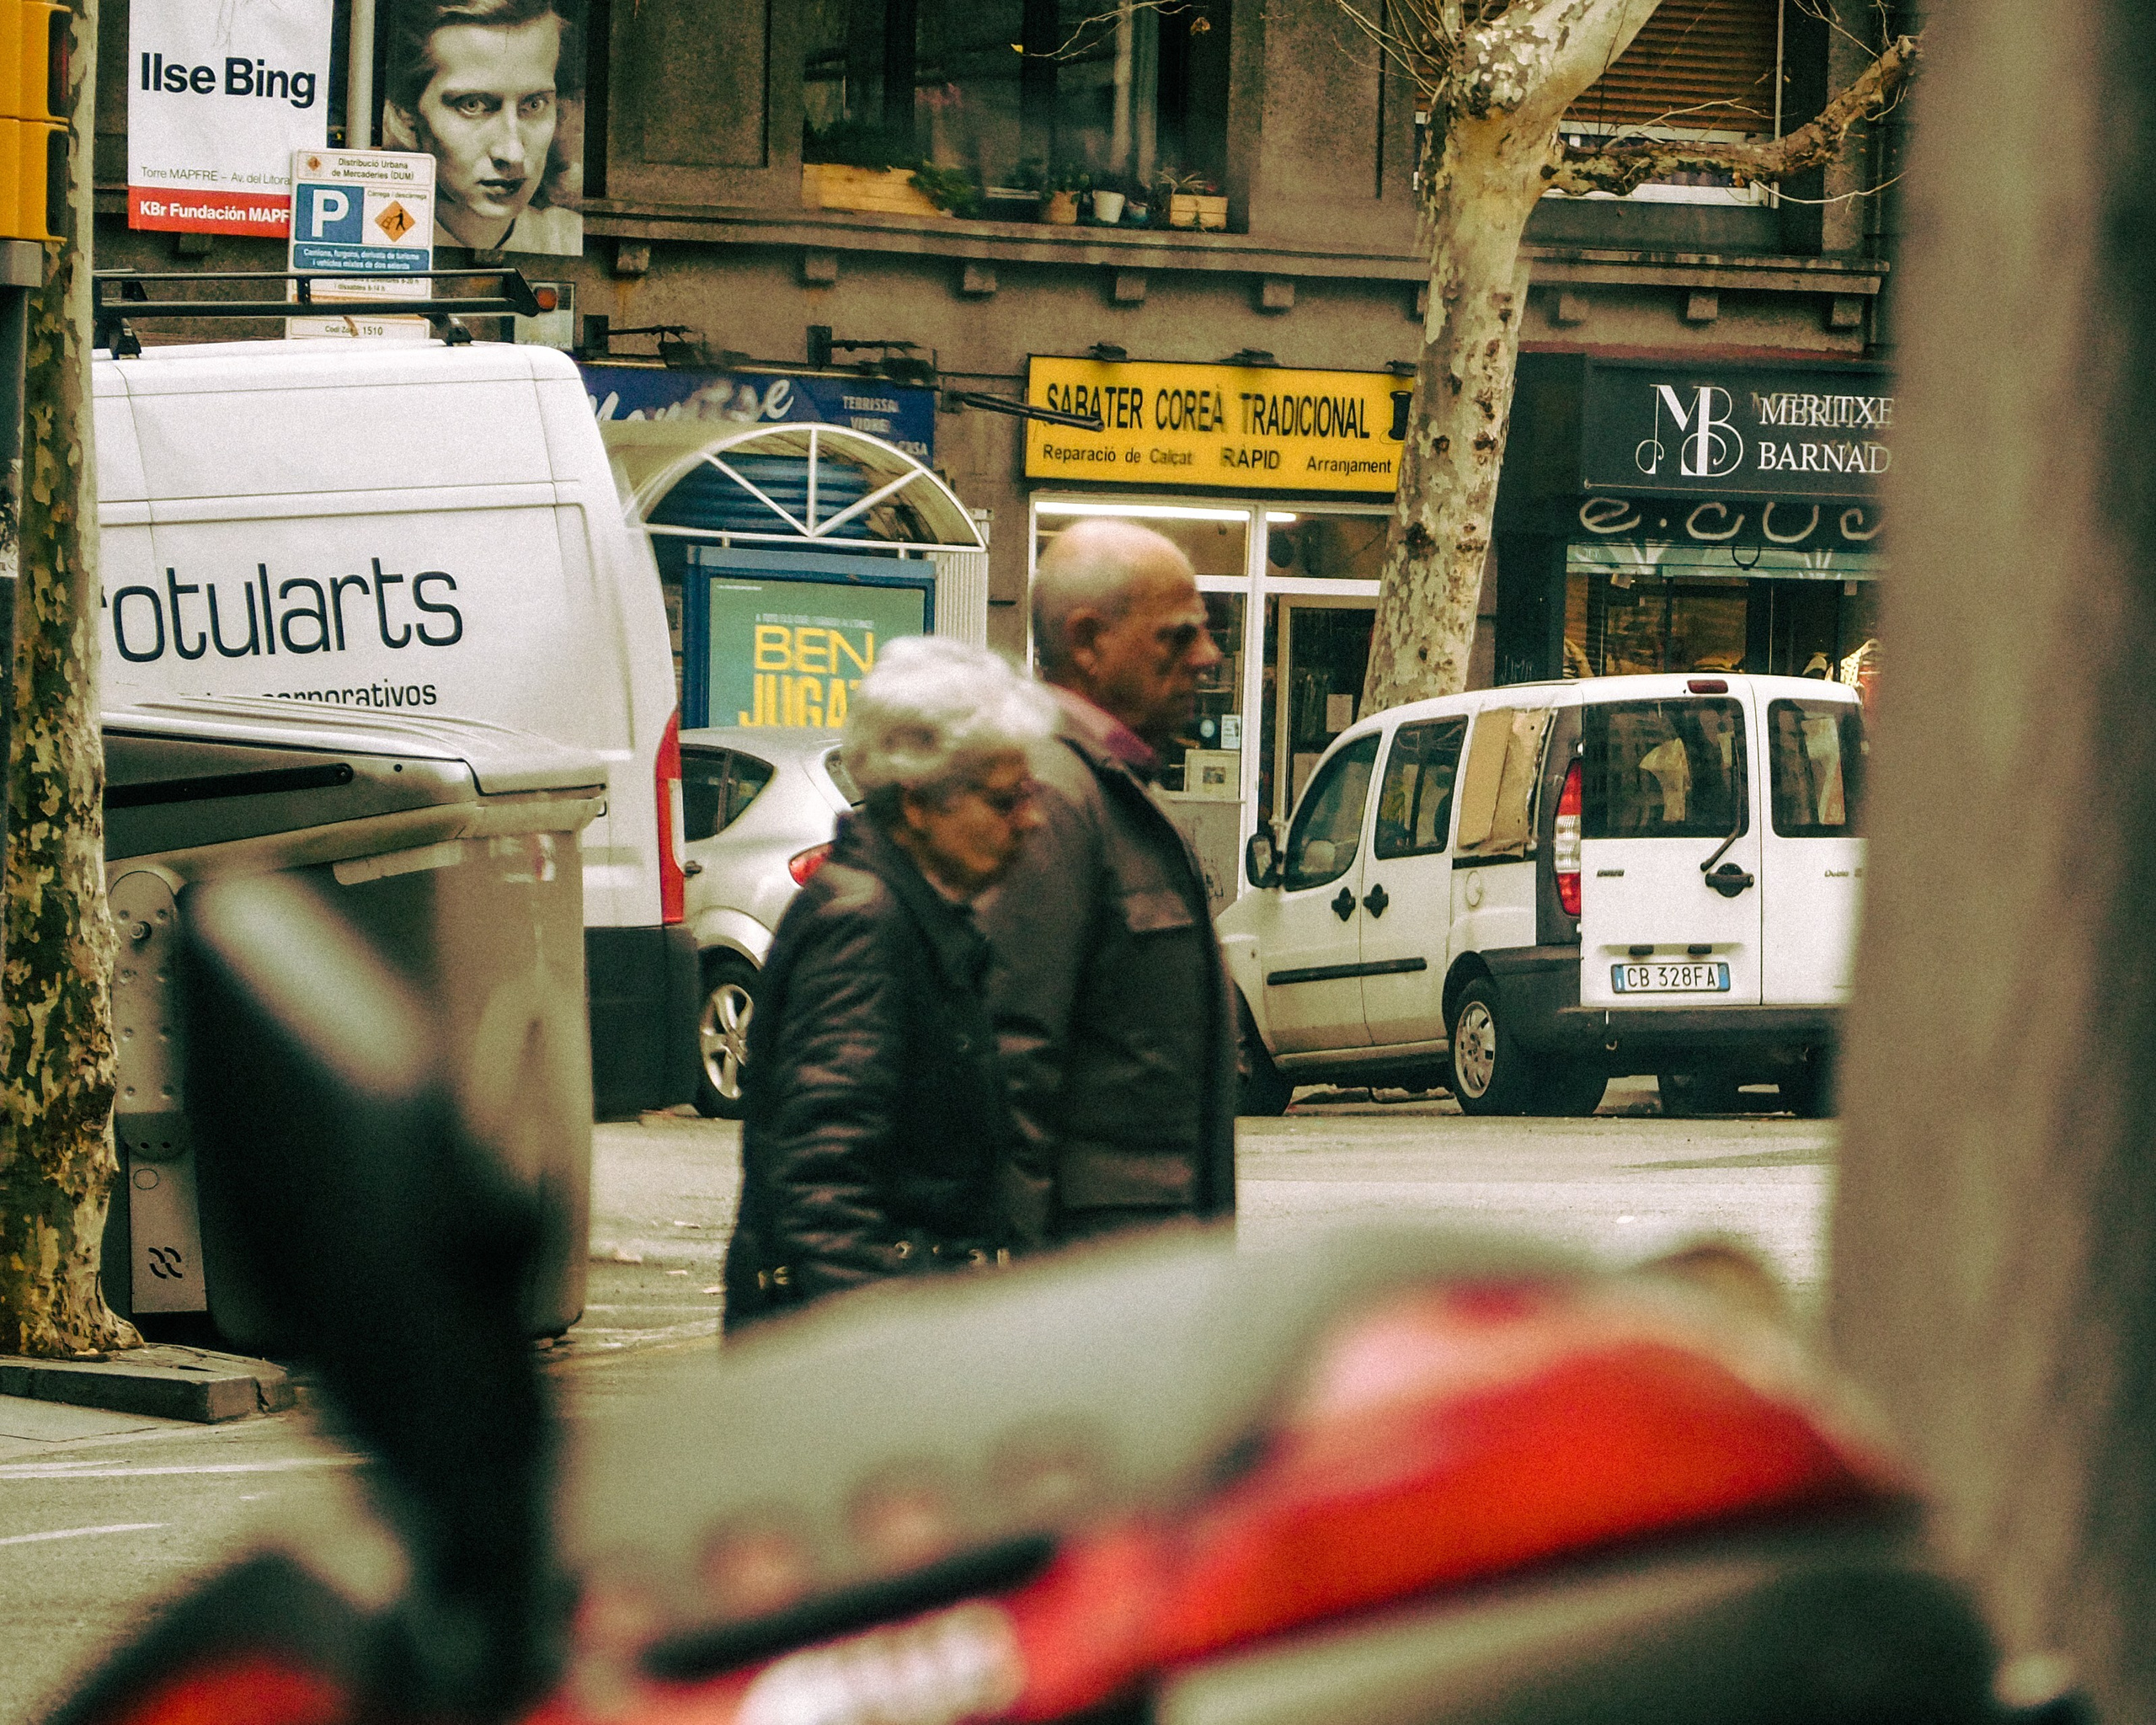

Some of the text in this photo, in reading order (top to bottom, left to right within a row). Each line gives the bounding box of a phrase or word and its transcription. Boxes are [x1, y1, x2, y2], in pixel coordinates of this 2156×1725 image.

[141, 52, 316, 109] Ilse Bing
[141, 166, 167, 179] Torre
[169, 168, 218, 181] MAPFRE
[231, 172, 244, 183] Av.
[247, 174, 261, 184] del
[339, 158, 408, 168] Distribució Urbana
[344, 170, 388, 179] Mercaderies
[391, 171, 414, 180] (DUM)
[140, 200, 167, 216] KBr
[170, 202, 245, 221] Fundación
[312, 190, 350, 238] P
[363, 326, 383, 335] 1510
[1048, 383, 1144, 429] SABATER
[1240, 393, 1370, 438] TRADICIONAL
[1043, 444, 1117, 462] Reparació
[1125, 447, 1141, 462] de
[1307, 456, 1391, 475] Arranjament
[100, 557, 462, 662] otularts
[755, 624, 874, 675] BEN
[262, 678, 436, 708] orativos
[739, 674, 861, 729] JUGA
[1627, 968, 1650, 987] CB
[1657, 966, 1716, 987] 328FA
